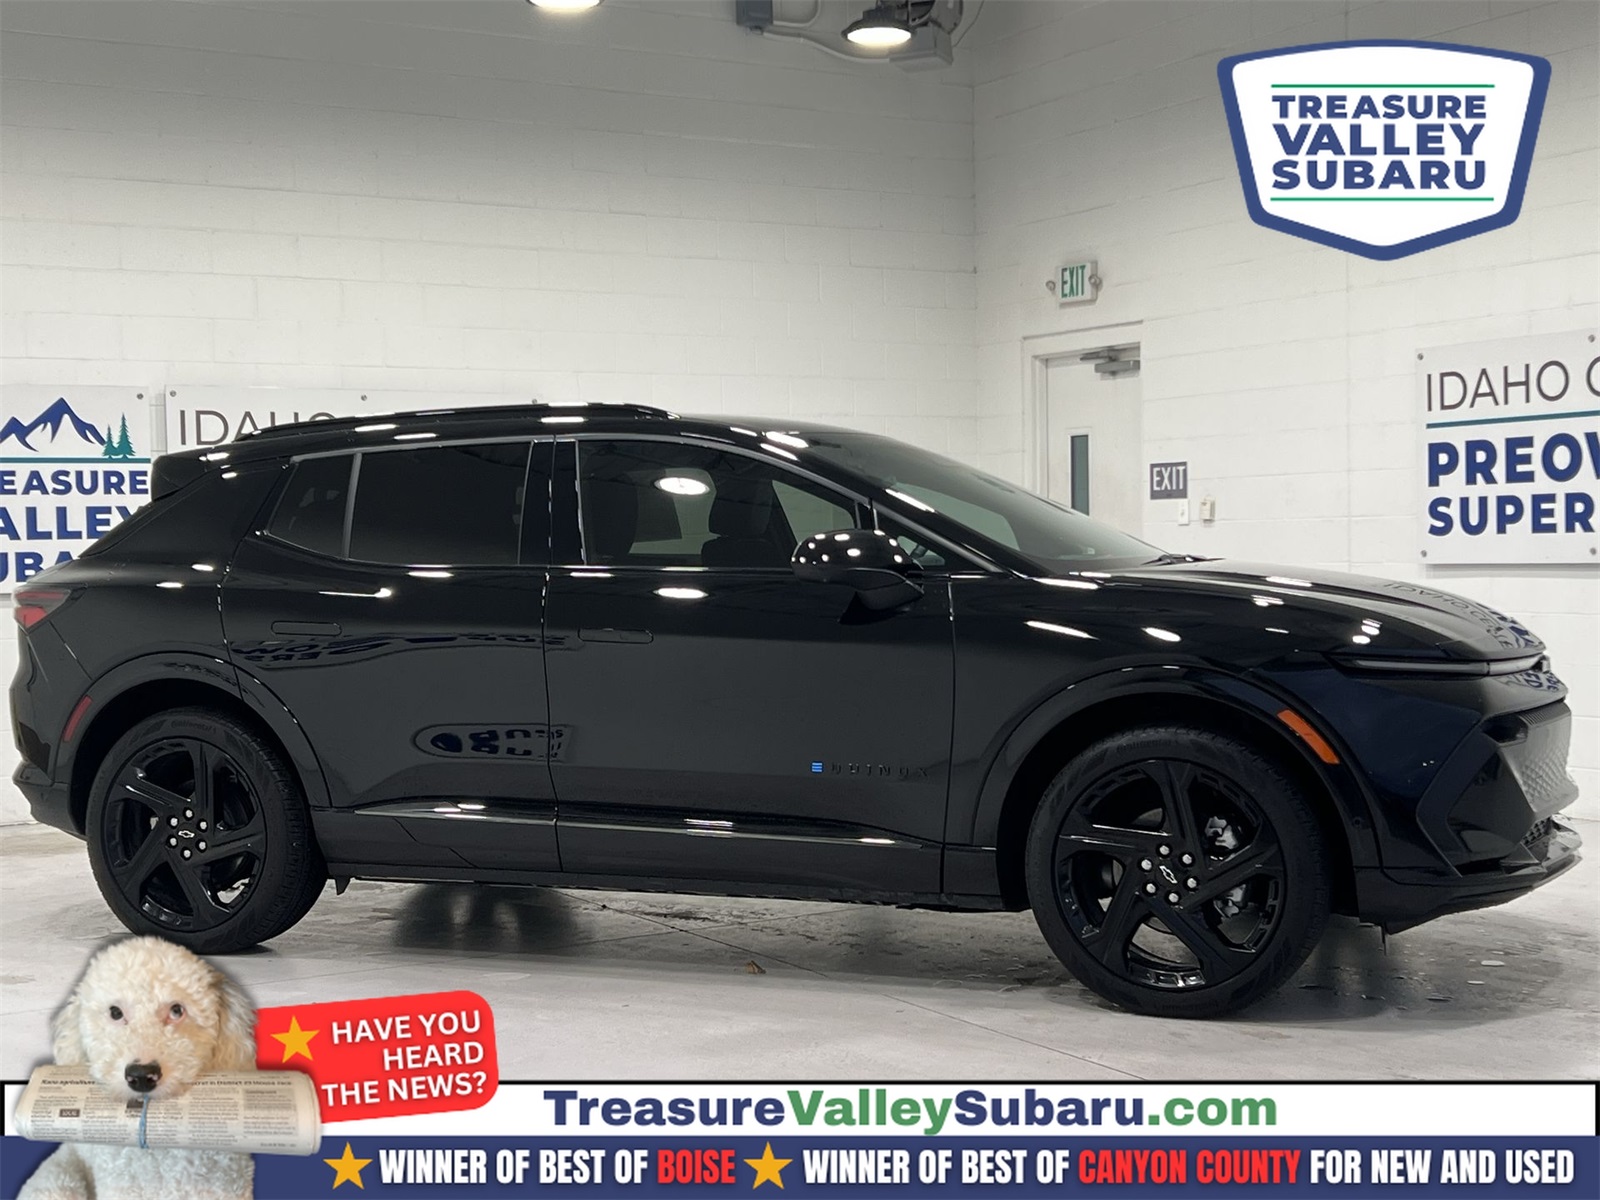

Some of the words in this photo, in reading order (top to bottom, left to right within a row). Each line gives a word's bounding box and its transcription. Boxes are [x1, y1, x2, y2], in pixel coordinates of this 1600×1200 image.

[1061, 265, 1086, 299] EXIT
[1426, 360, 1570, 412] IDAHO
[179, 410, 336, 446] IDA
[1153, 466, 1186, 491] EXIT
